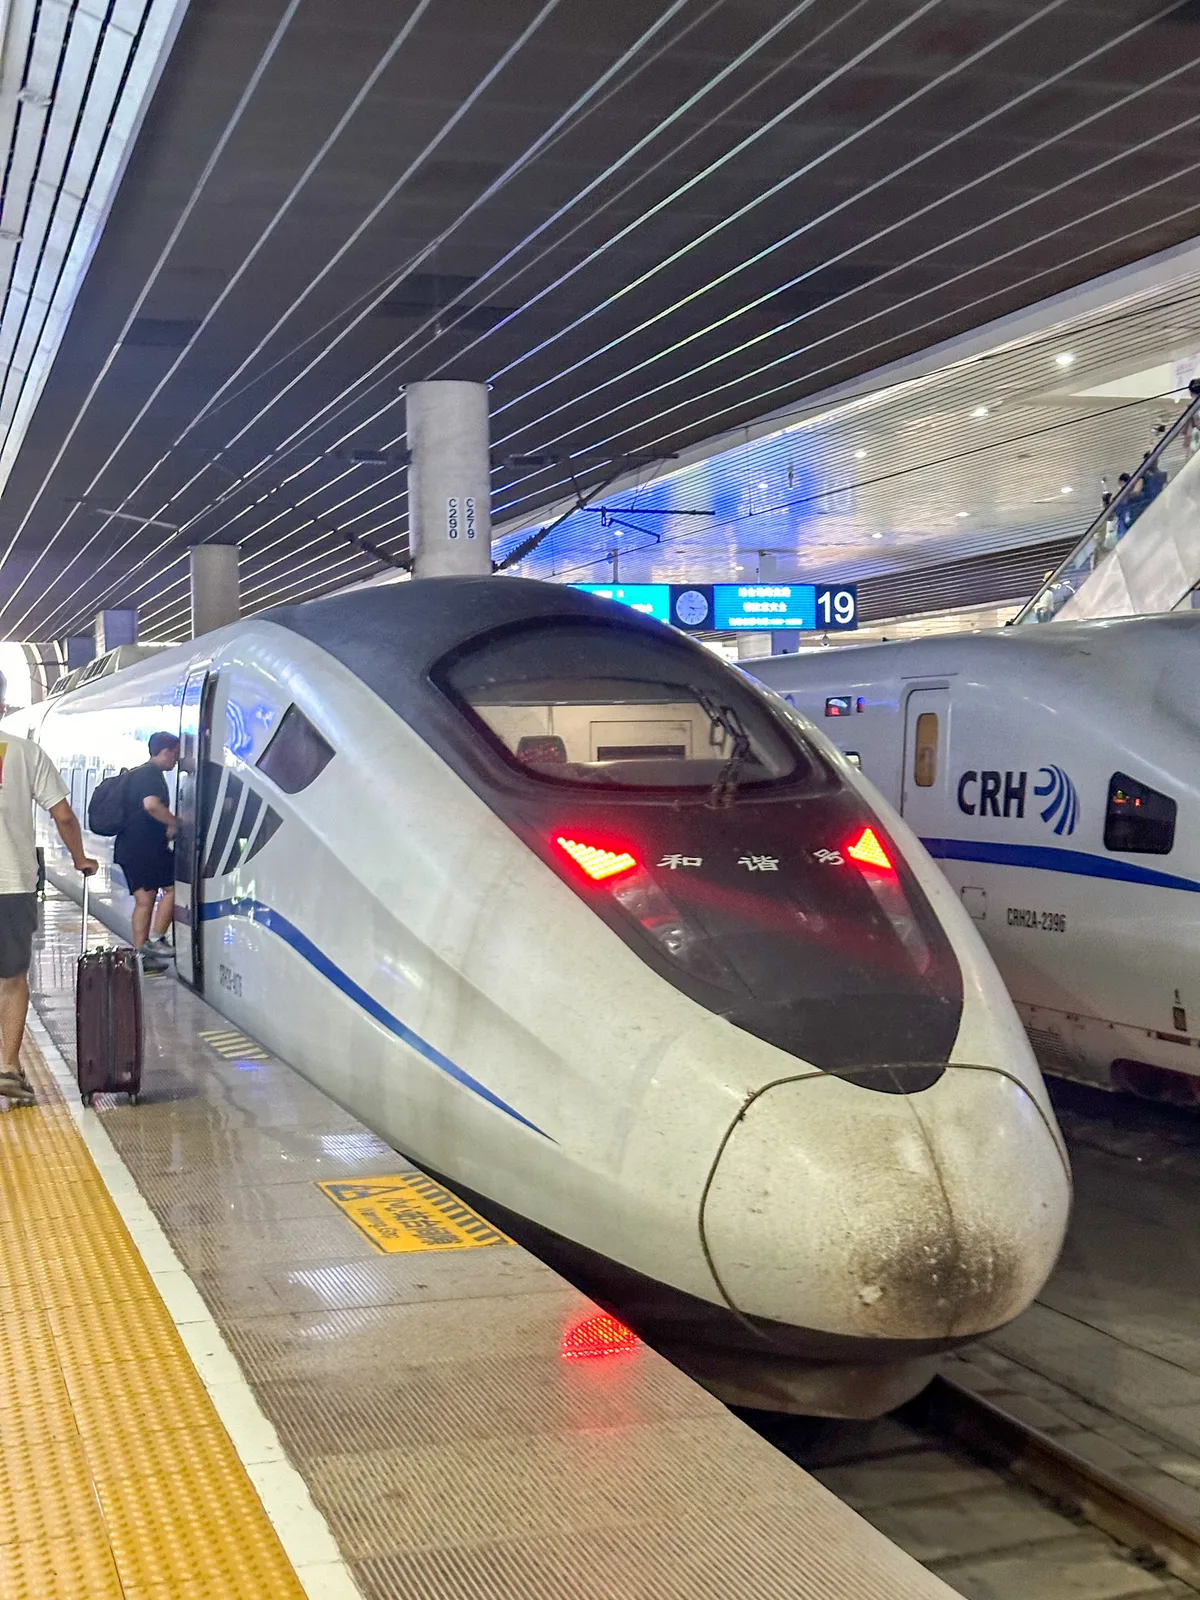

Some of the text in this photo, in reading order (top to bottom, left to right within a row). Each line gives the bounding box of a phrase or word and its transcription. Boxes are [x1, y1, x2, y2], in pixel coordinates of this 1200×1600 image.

[448, 498, 458, 539] C290
[466, 498, 475, 539] C279
[817, 591, 855, 624] 19
[957, 770, 1028, 819] CRH
[1007, 908, 1067, 933] CRH2A-2396
